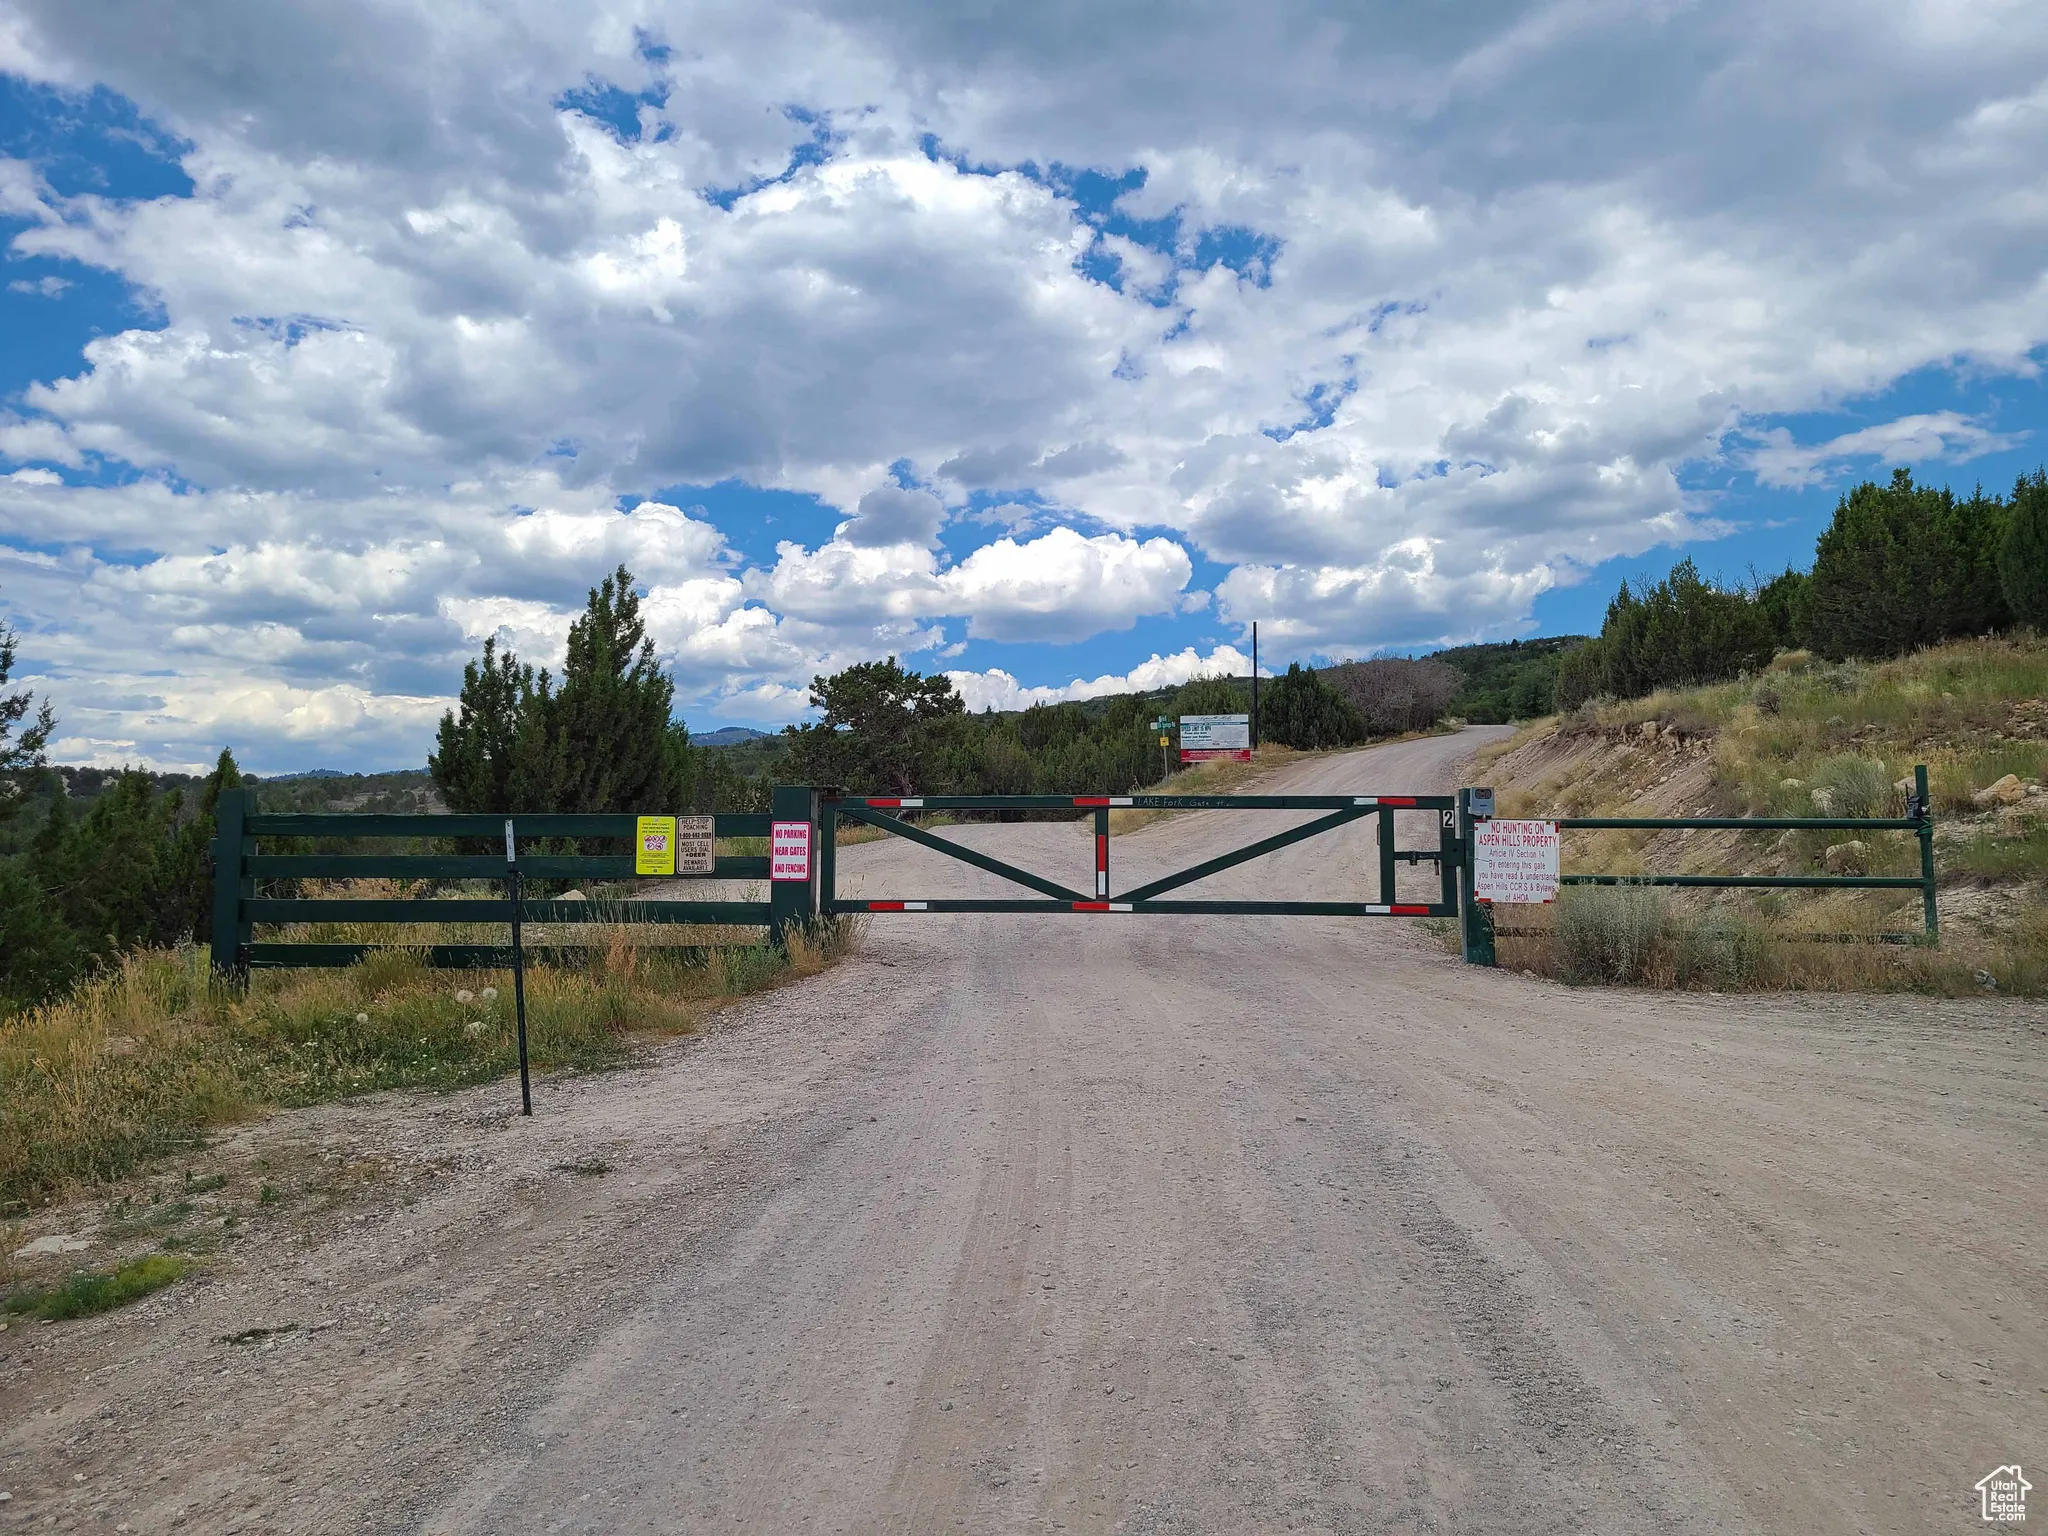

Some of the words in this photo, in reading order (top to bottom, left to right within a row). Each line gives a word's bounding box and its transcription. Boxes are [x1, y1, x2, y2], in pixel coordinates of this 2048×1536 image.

[1137, 797, 1159, 806] LAKE
[1444, 811, 1453, 826] 2
[1491, 822, 1500, 834] NO
[1503, 822, 1532, 834] HUNTING
[1536, 823, 1544, 834] ON
[776, 829, 782, 838] NO
[784, 830, 806, 838] PARKING
[1479, 835, 1499, 846] ASPEN
[1502, 835, 1521, 846] HILLS
[1523, 836, 1557, 847] PROPERTY
[775, 847, 788, 856] NEAR
[790, 847, 806, 856] GATES
[1489, 849, 1506, 857] Article
[1516, 850, 1536, 858] Section
[775, 864, 784, 872] AND
[785, 864, 805, 872] FENCING
[1489, 860, 1495, 870] By
[1498, 861, 1520, 870] entering
[1534, 862, 1545, 871] gate
[1490, 871, 1503, 879] have
[1526, 872, 1556, 880] understand
[1477, 882, 1493, 891] Aspen
[1496, 882, 1508, 890] Hills
[1536, 884, 1555, 893] Bylaws
[1505, 893, 1511, 901] of
